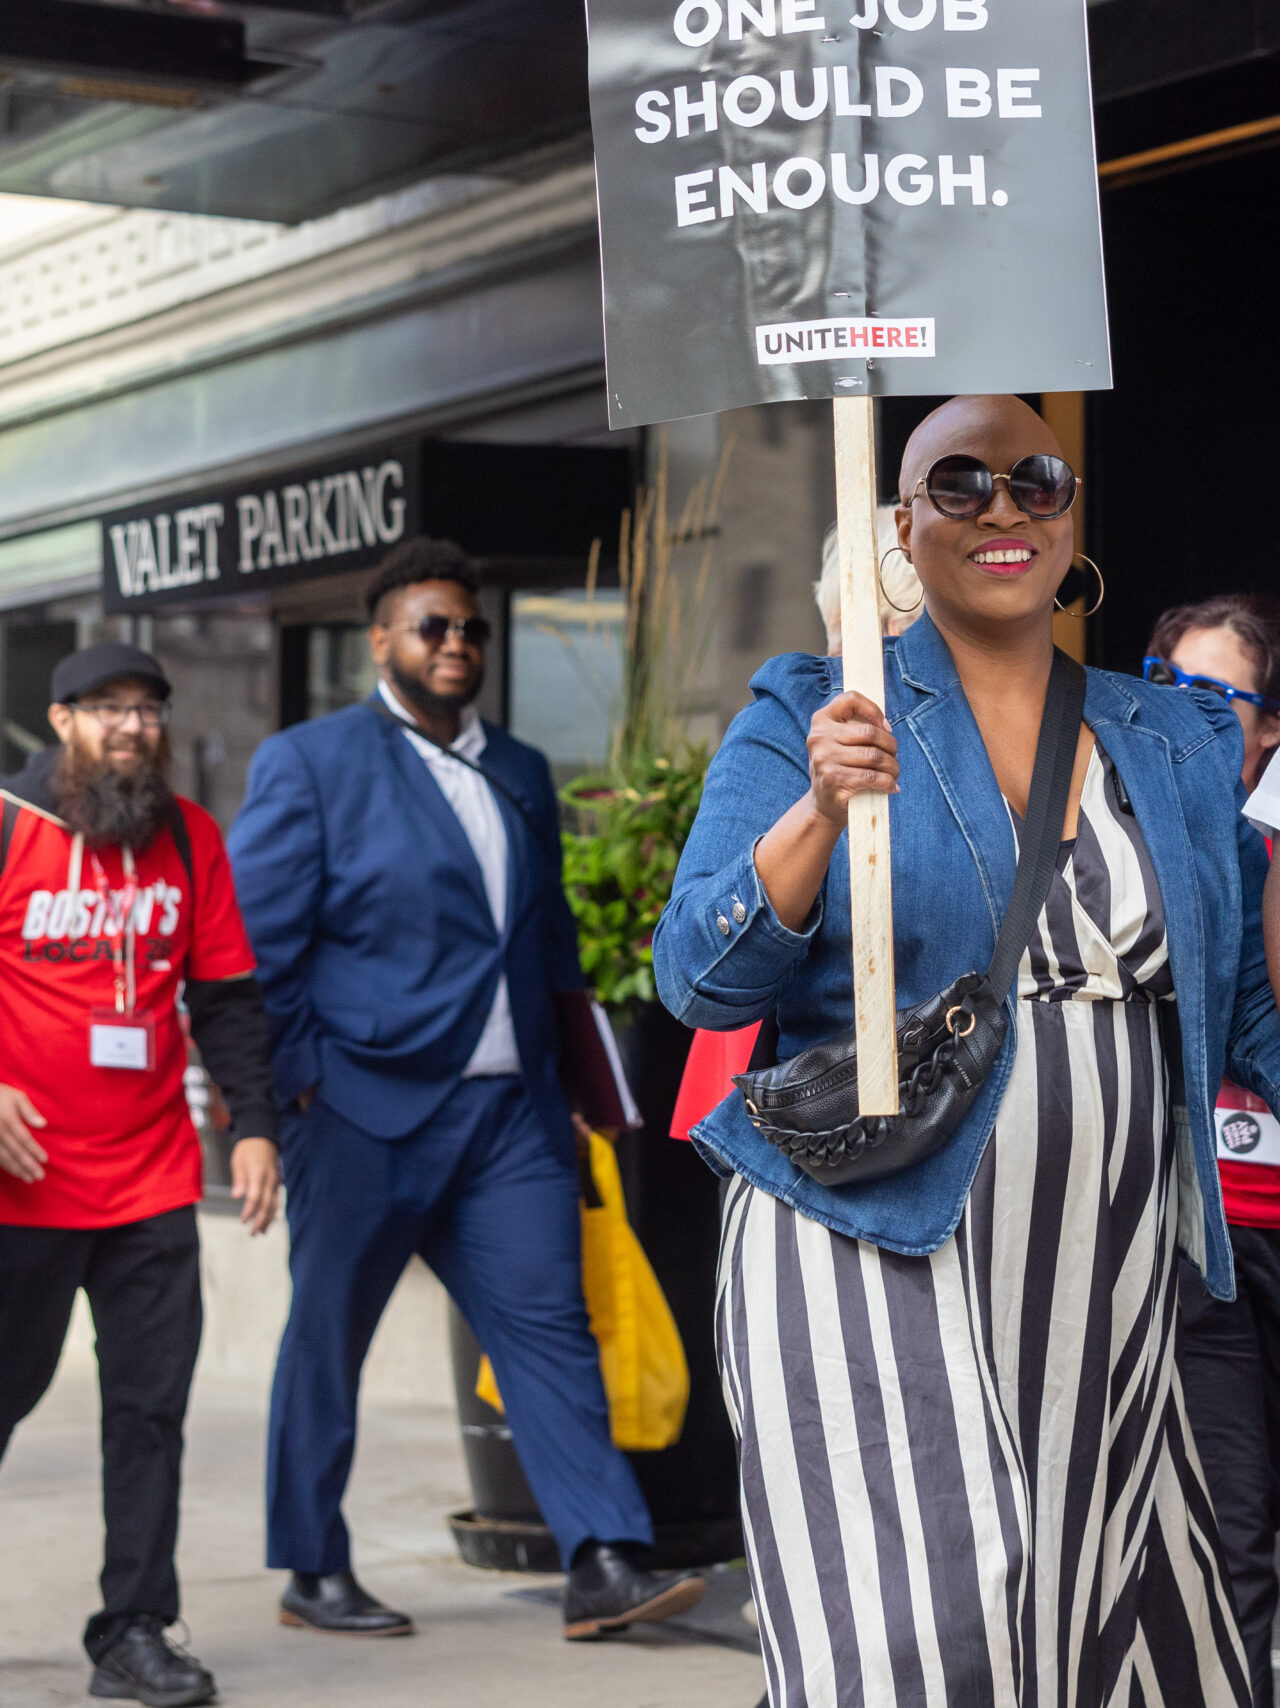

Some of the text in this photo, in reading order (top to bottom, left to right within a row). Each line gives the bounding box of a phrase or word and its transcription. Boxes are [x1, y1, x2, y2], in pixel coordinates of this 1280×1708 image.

[673, 0, 989, 47] ONE JOB
[634, 66, 1043, 144] SHOULD BE
[674, 152, 1009, 227] ENOUGH.
[764, 325, 927, 355] UNITEHERE!
[109, 459, 406, 598] VALET PARKING
